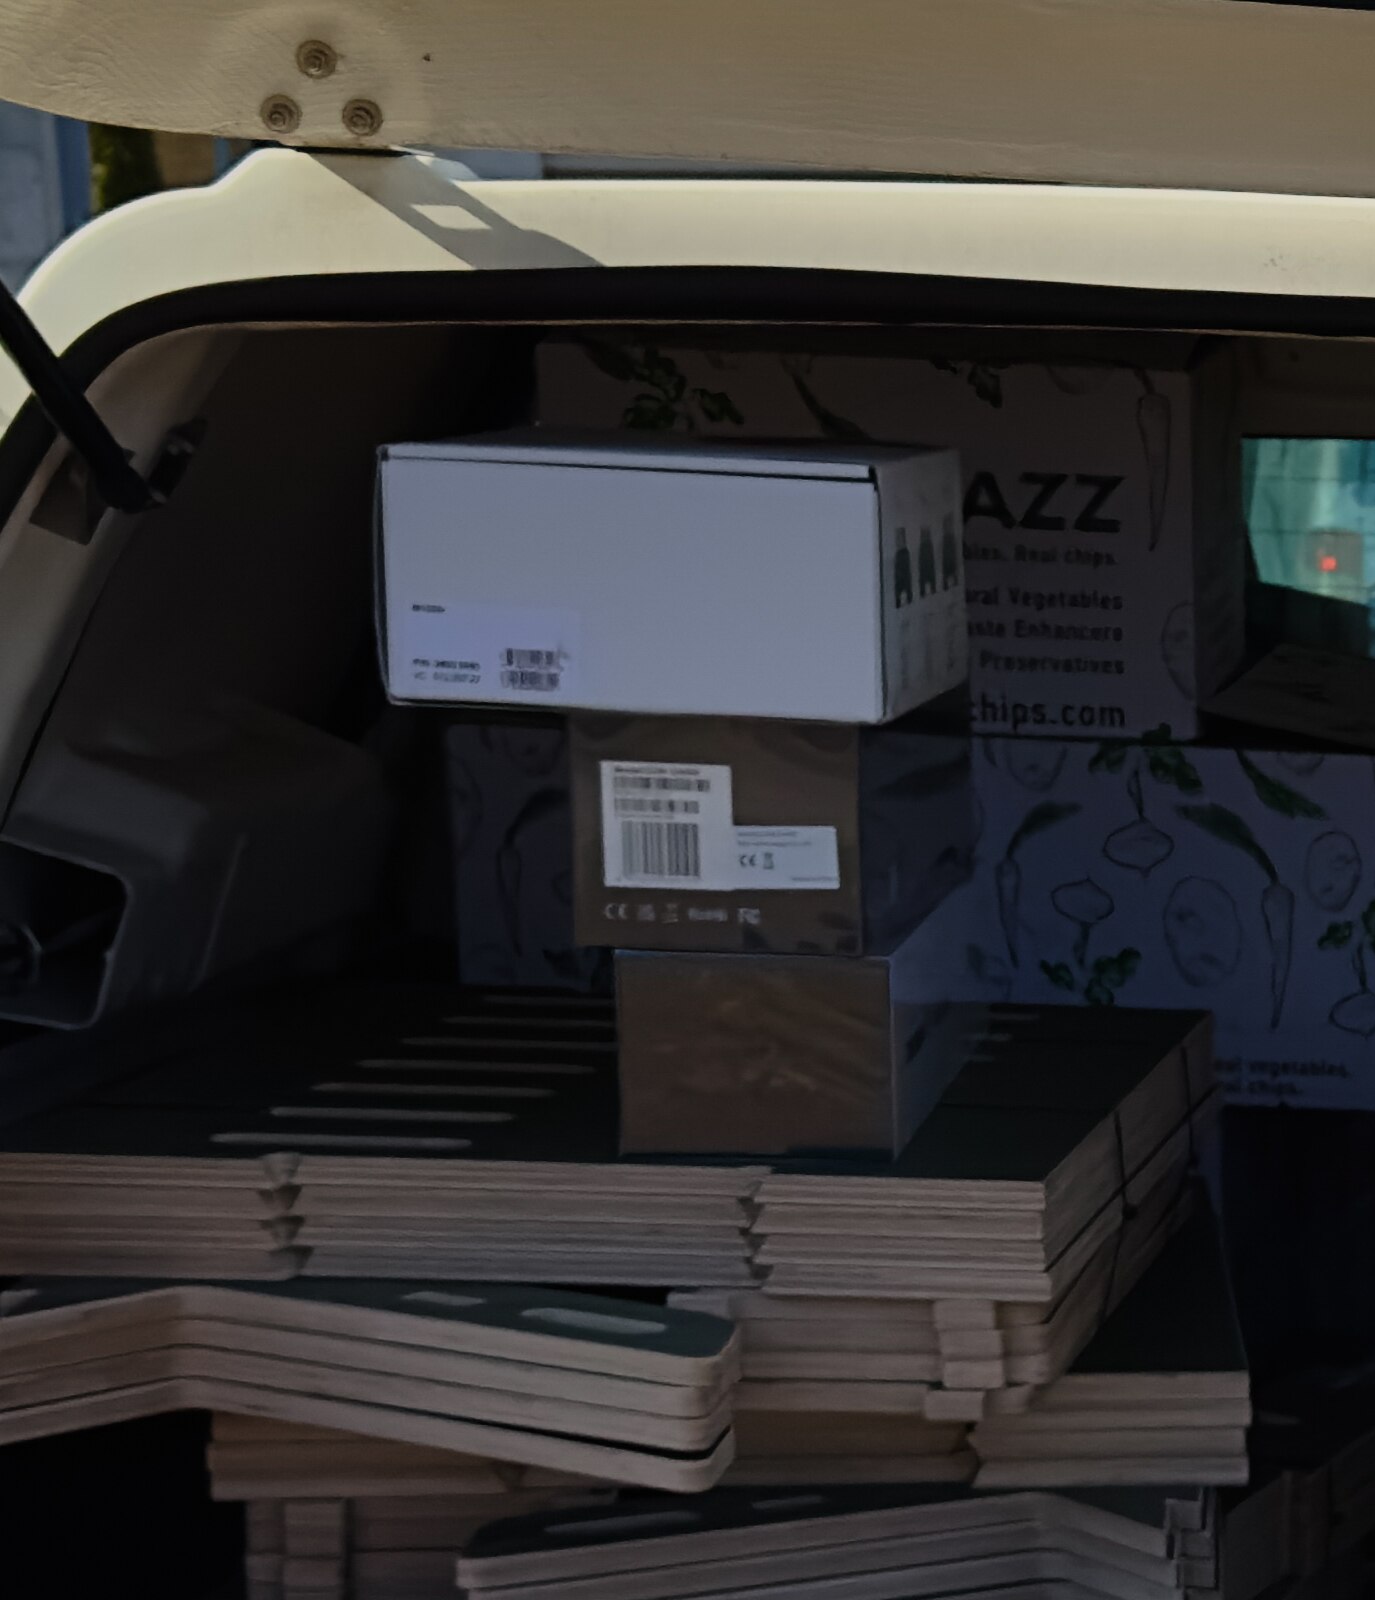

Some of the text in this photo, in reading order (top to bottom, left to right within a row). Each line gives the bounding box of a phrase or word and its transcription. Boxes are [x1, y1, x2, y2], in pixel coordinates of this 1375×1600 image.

[1008, 588, 1123, 611] Vegetables
[1013, 619, 1123, 642] Enhancers
[980, 649, 1126, 674] Preservatives
